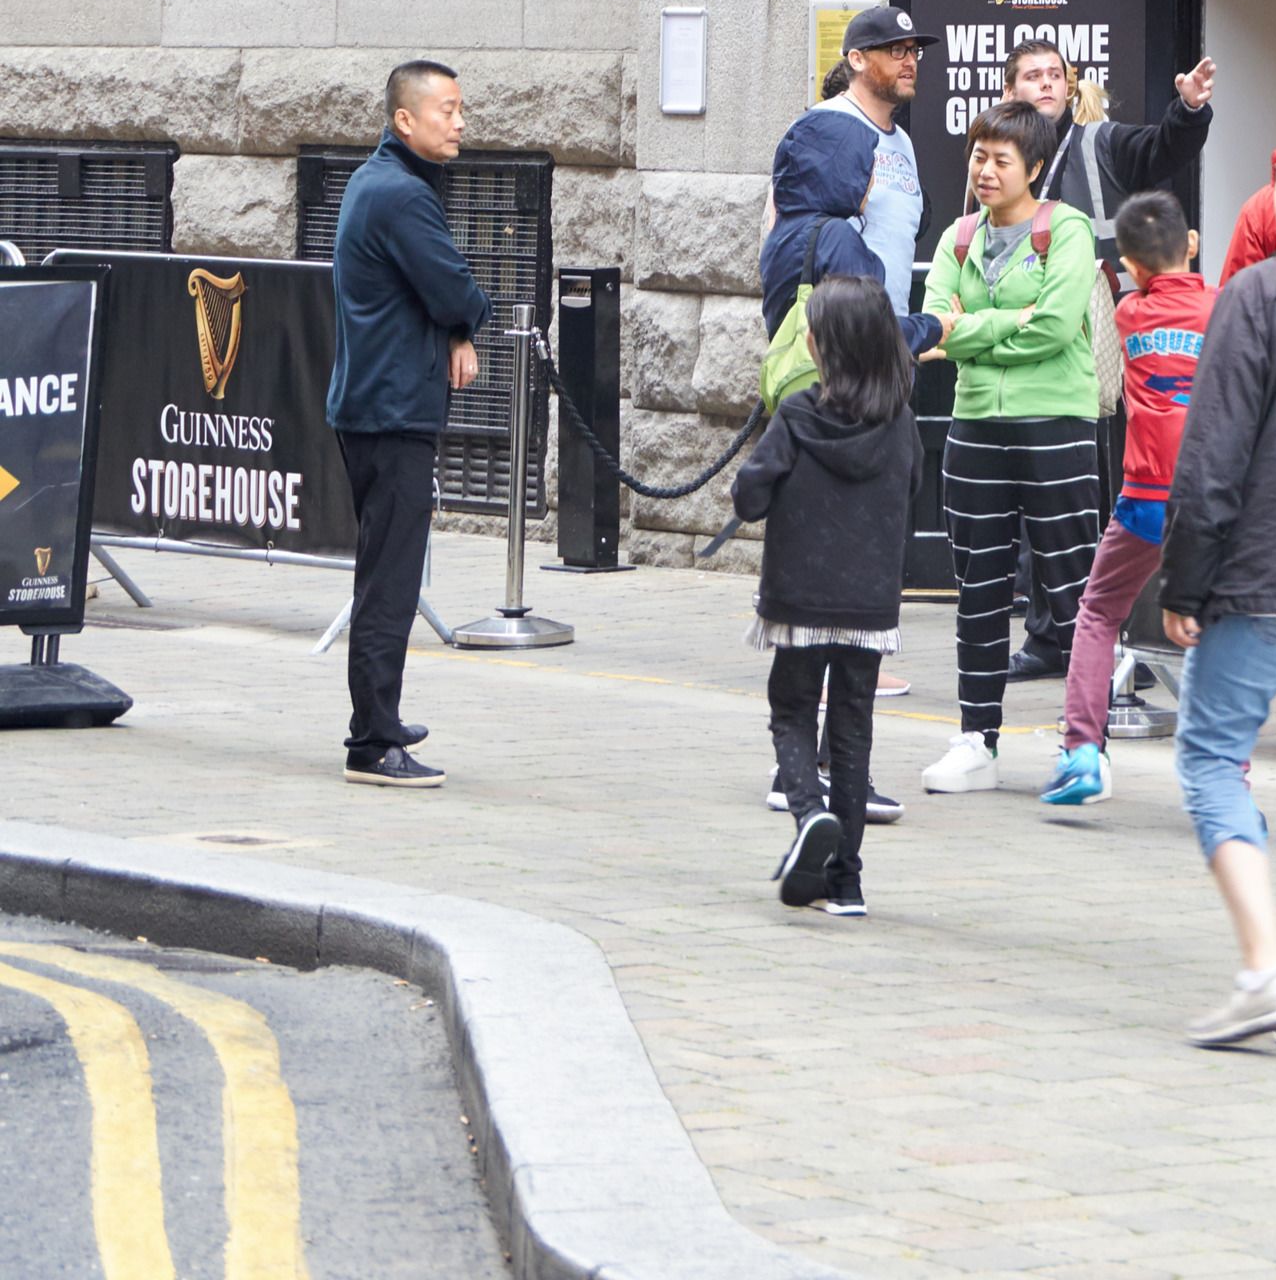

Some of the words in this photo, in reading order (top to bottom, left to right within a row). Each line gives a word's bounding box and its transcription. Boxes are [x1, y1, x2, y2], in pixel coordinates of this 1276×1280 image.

[947, 67, 971, 91] TO
[160, 404, 273, 451] GUINNESS
[131, 457, 302, 531] STOREHOUSE
[8, 584, 66, 602] STOREHOUSE
[22, 576, 58, 587] GUINNESS
